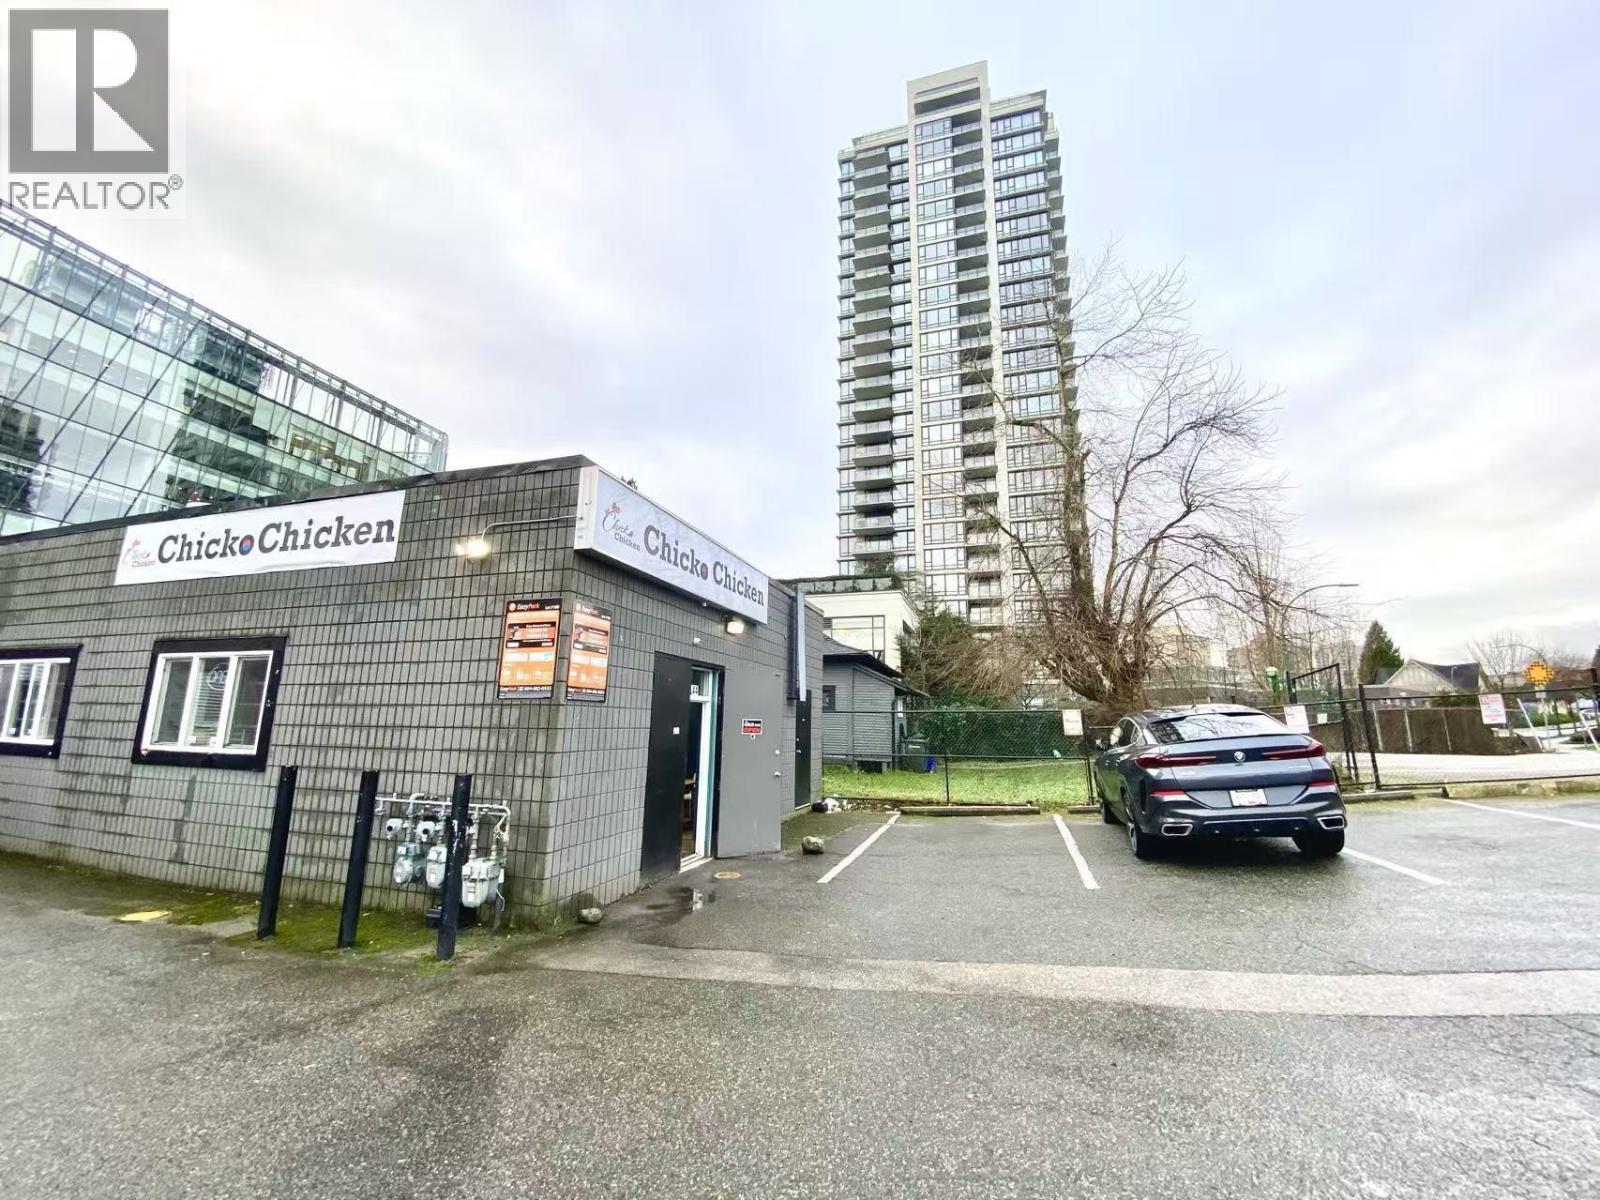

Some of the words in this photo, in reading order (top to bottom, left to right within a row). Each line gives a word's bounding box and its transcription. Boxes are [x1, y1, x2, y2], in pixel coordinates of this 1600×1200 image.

[157, 528, 255, 564] Chicko
[258, 516, 395, 554] Chicken
[614, 532, 641, 551] Chicken
[643, 524, 709, 580] Chicko
[713, 560, 764, 606] Chicken
